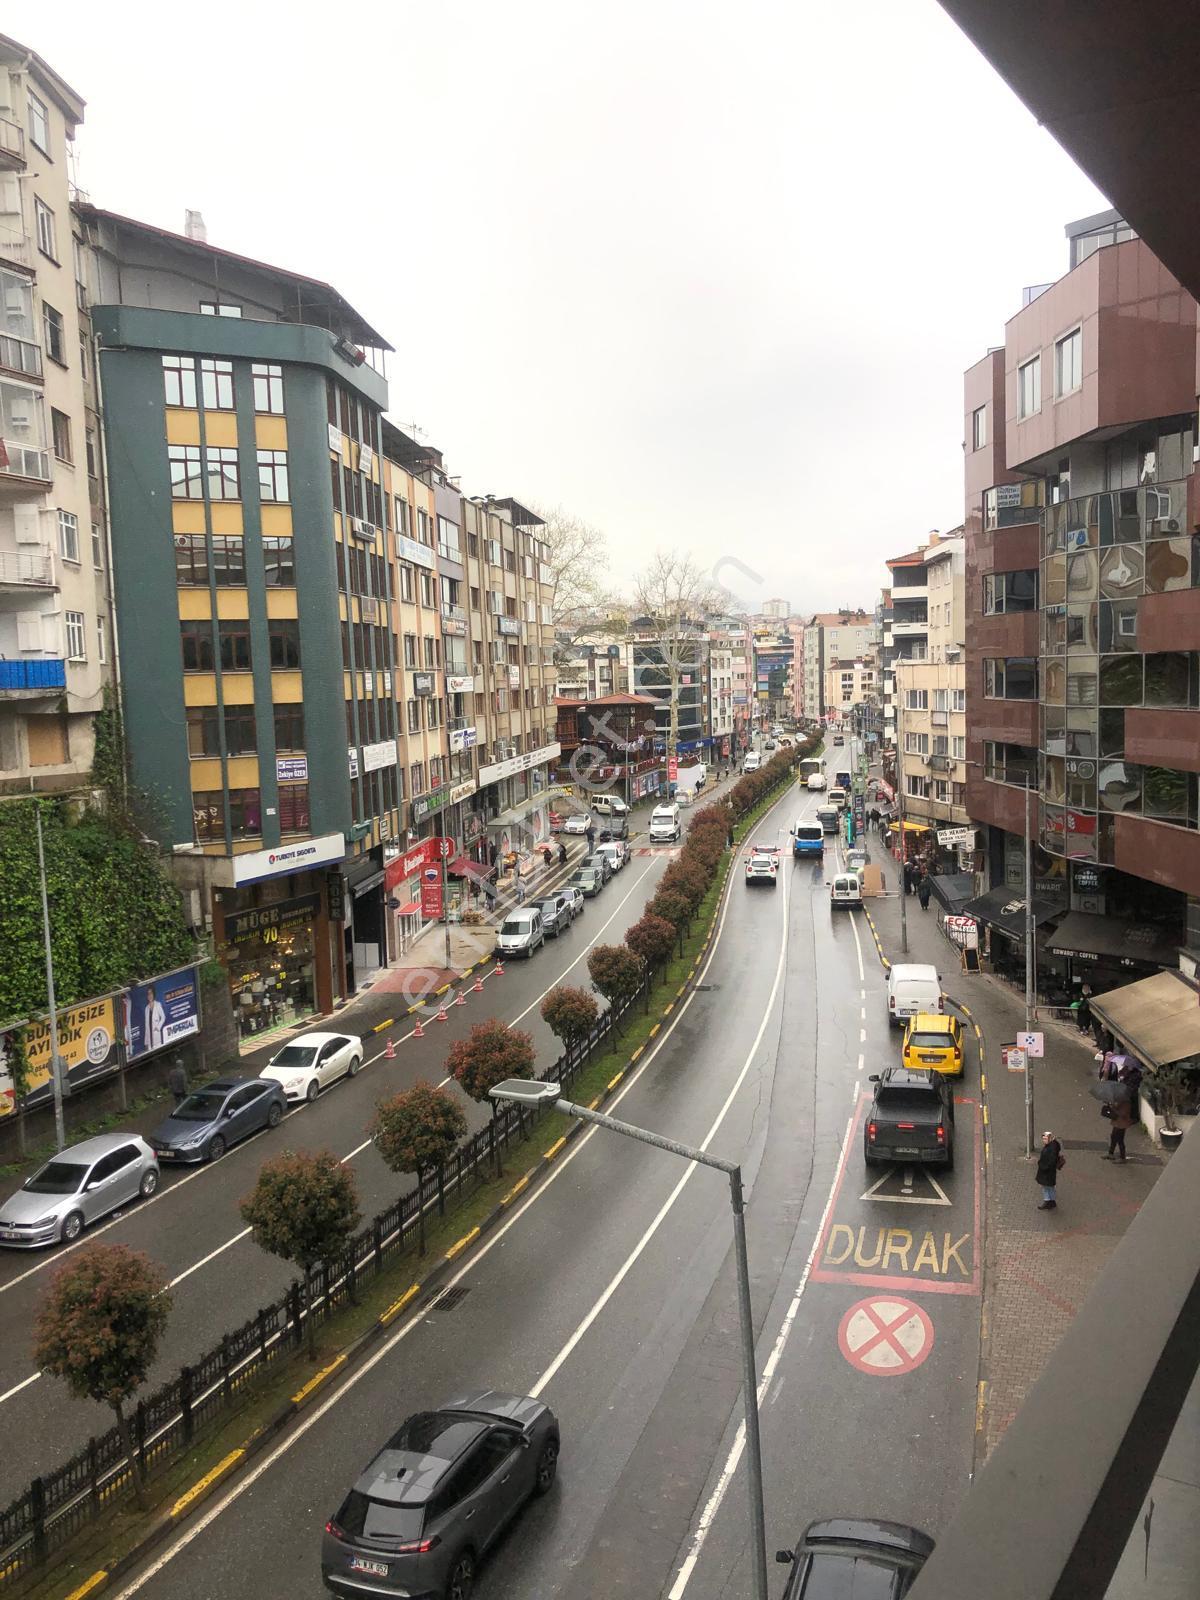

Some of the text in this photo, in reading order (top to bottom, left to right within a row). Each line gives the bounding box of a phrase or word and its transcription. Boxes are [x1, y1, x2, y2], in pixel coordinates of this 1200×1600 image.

[236, 908, 279, 932] MÜGE
[1079, 952, 1099, 960] COFFEE
[78, 1003, 105, 1024] SİZE
[28, 1027, 82, 1058] AYIDIK
[823, 1223, 971, 1276] DURAK
